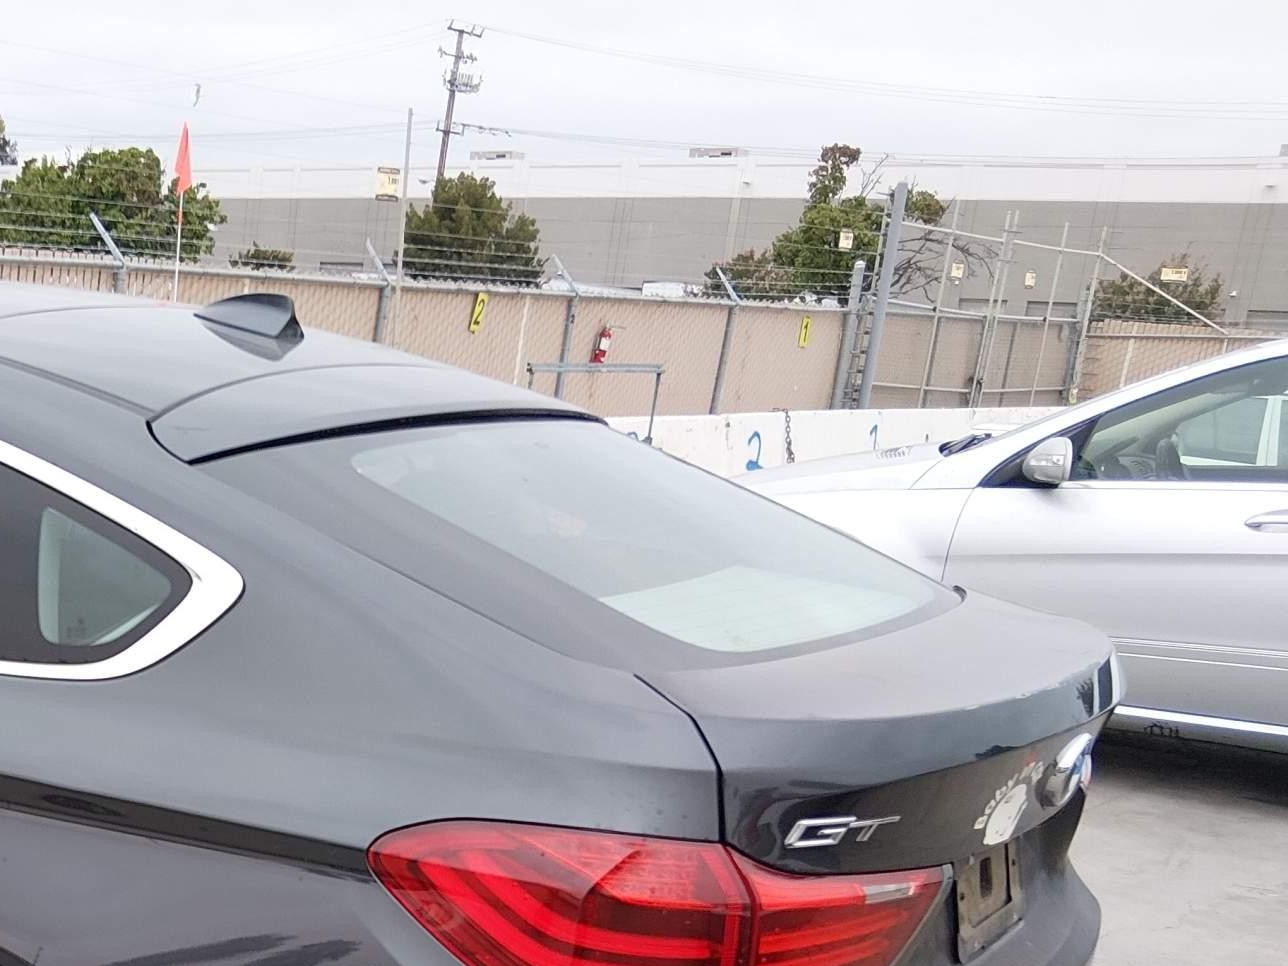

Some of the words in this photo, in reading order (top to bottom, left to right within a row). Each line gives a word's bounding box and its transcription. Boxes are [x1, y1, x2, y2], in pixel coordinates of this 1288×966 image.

[473, 298, 485, 325] 2
[803, 321, 809, 343] 1
[783, 815, 901, 849] GT
